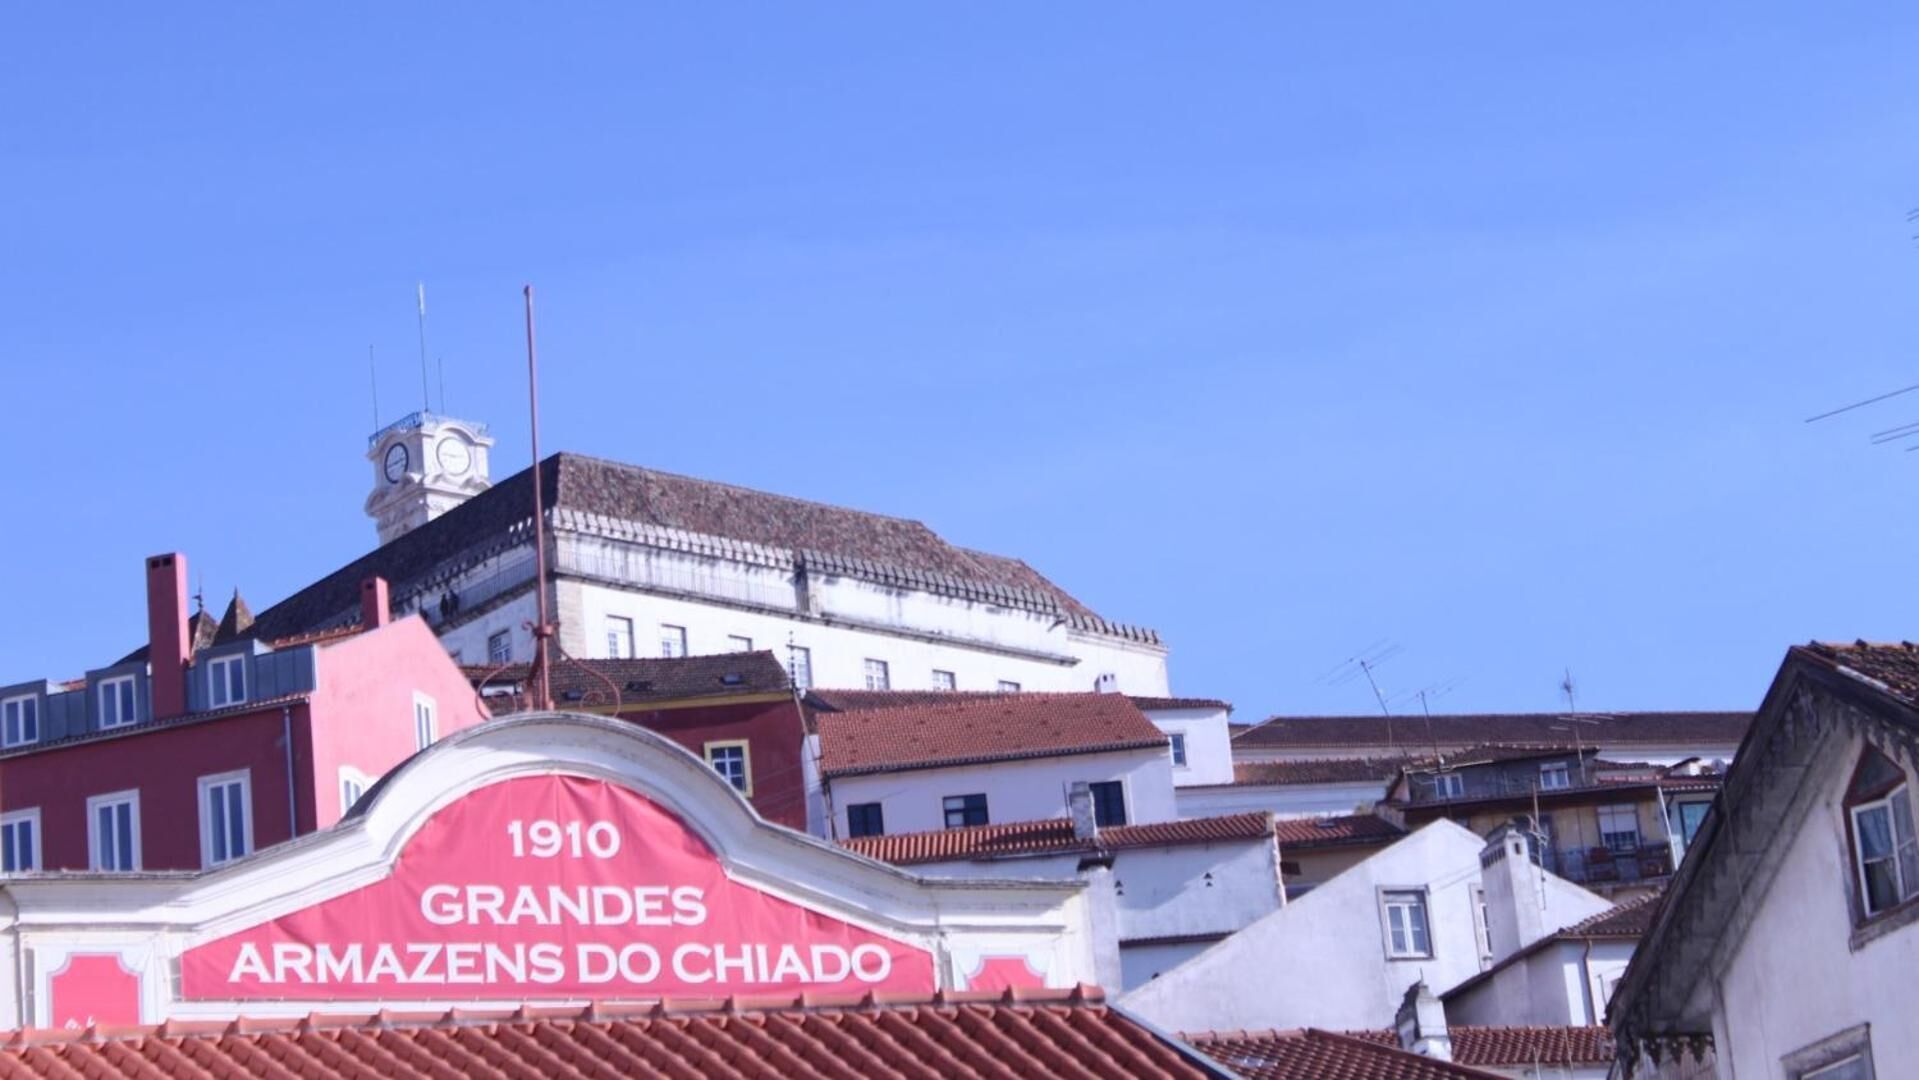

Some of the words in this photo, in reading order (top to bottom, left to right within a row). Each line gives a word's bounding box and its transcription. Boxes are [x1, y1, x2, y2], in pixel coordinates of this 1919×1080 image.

[507, 819, 621, 859] 1910
[420, 884, 708, 926] GRANDES
[228, 941, 565, 984] ARMAZENS
[576, 942, 661, 984] DO
[671, 942, 892, 984] CHIADO
